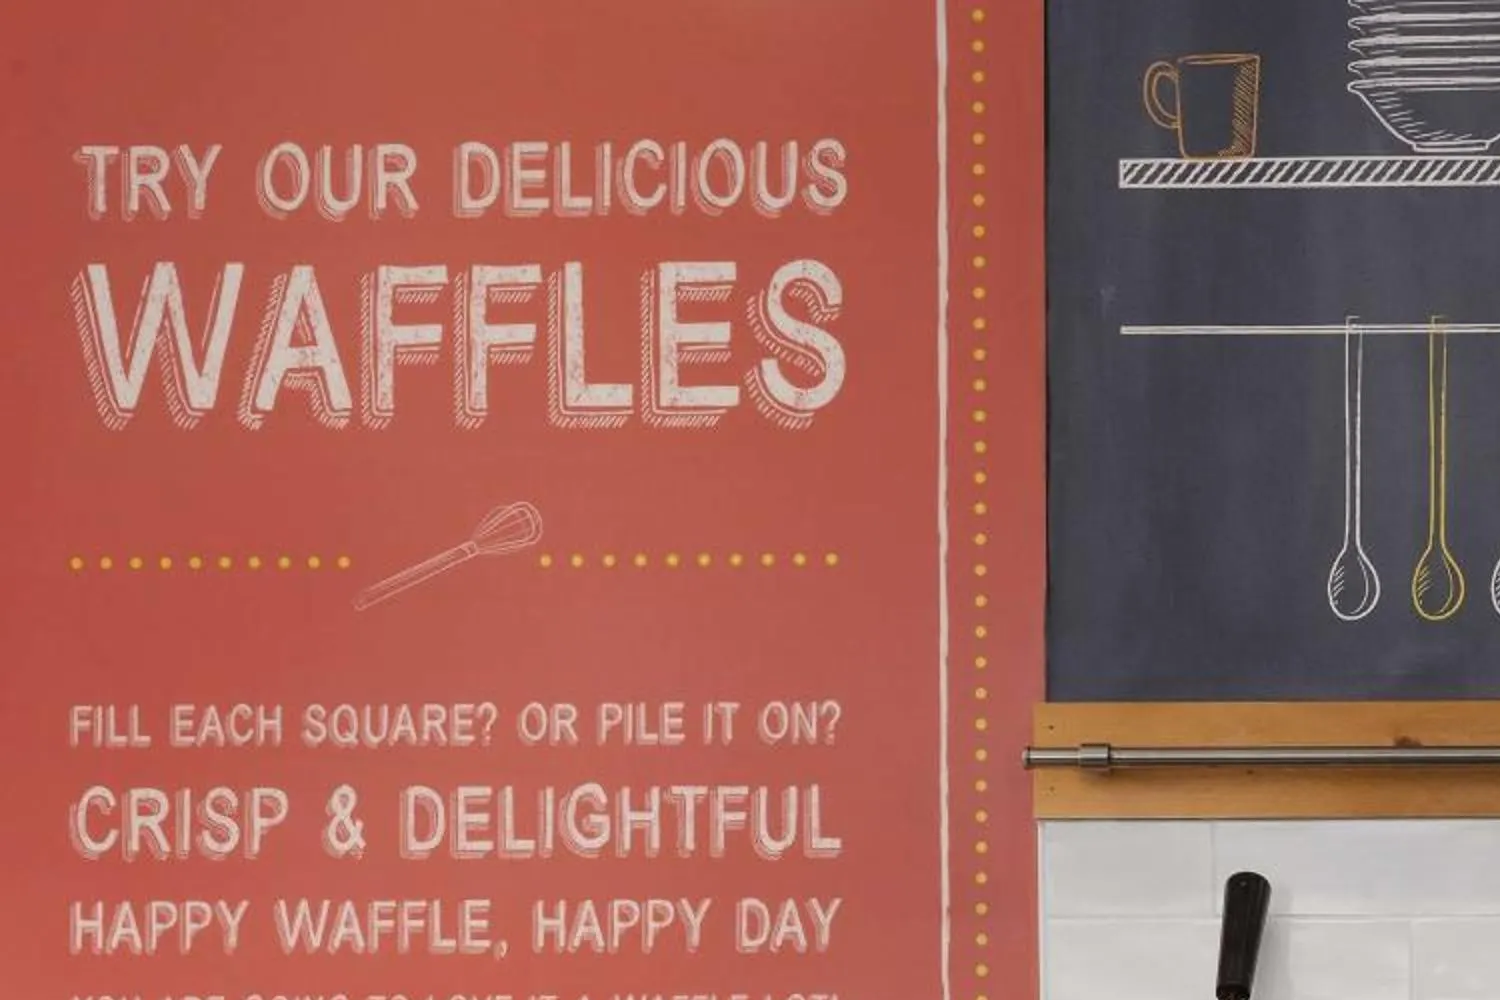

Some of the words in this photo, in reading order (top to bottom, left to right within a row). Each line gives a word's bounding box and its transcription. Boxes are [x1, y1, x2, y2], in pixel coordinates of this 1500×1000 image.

[74, 144, 222, 220] TRY
[257, 142, 419, 222] OUR
[454, 138, 847, 217] DELICIOUS
[71, 259, 846, 430] WAFFLES
[70, 705, 151, 747] FILL
[170, 704, 282, 746] EACH
[302, 702, 497, 748] SQUARE?
[518, 702, 578, 745] OR
[599, 702, 685, 744] PILE
[704, 702, 740, 744] IT
[759, 700, 841, 744] ON?
[70, 786, 288, 861] CRISP
[325, 784, 366, 858] &
[401, 783, 841, 860] DELIGHTFUL
[70, 900, 249, 954] HAPPY
[274, 898, 507, 957] WAFFLE,
[533, 898, 711, 953] HAPPY
[736, 898, 842, 953] DAY
